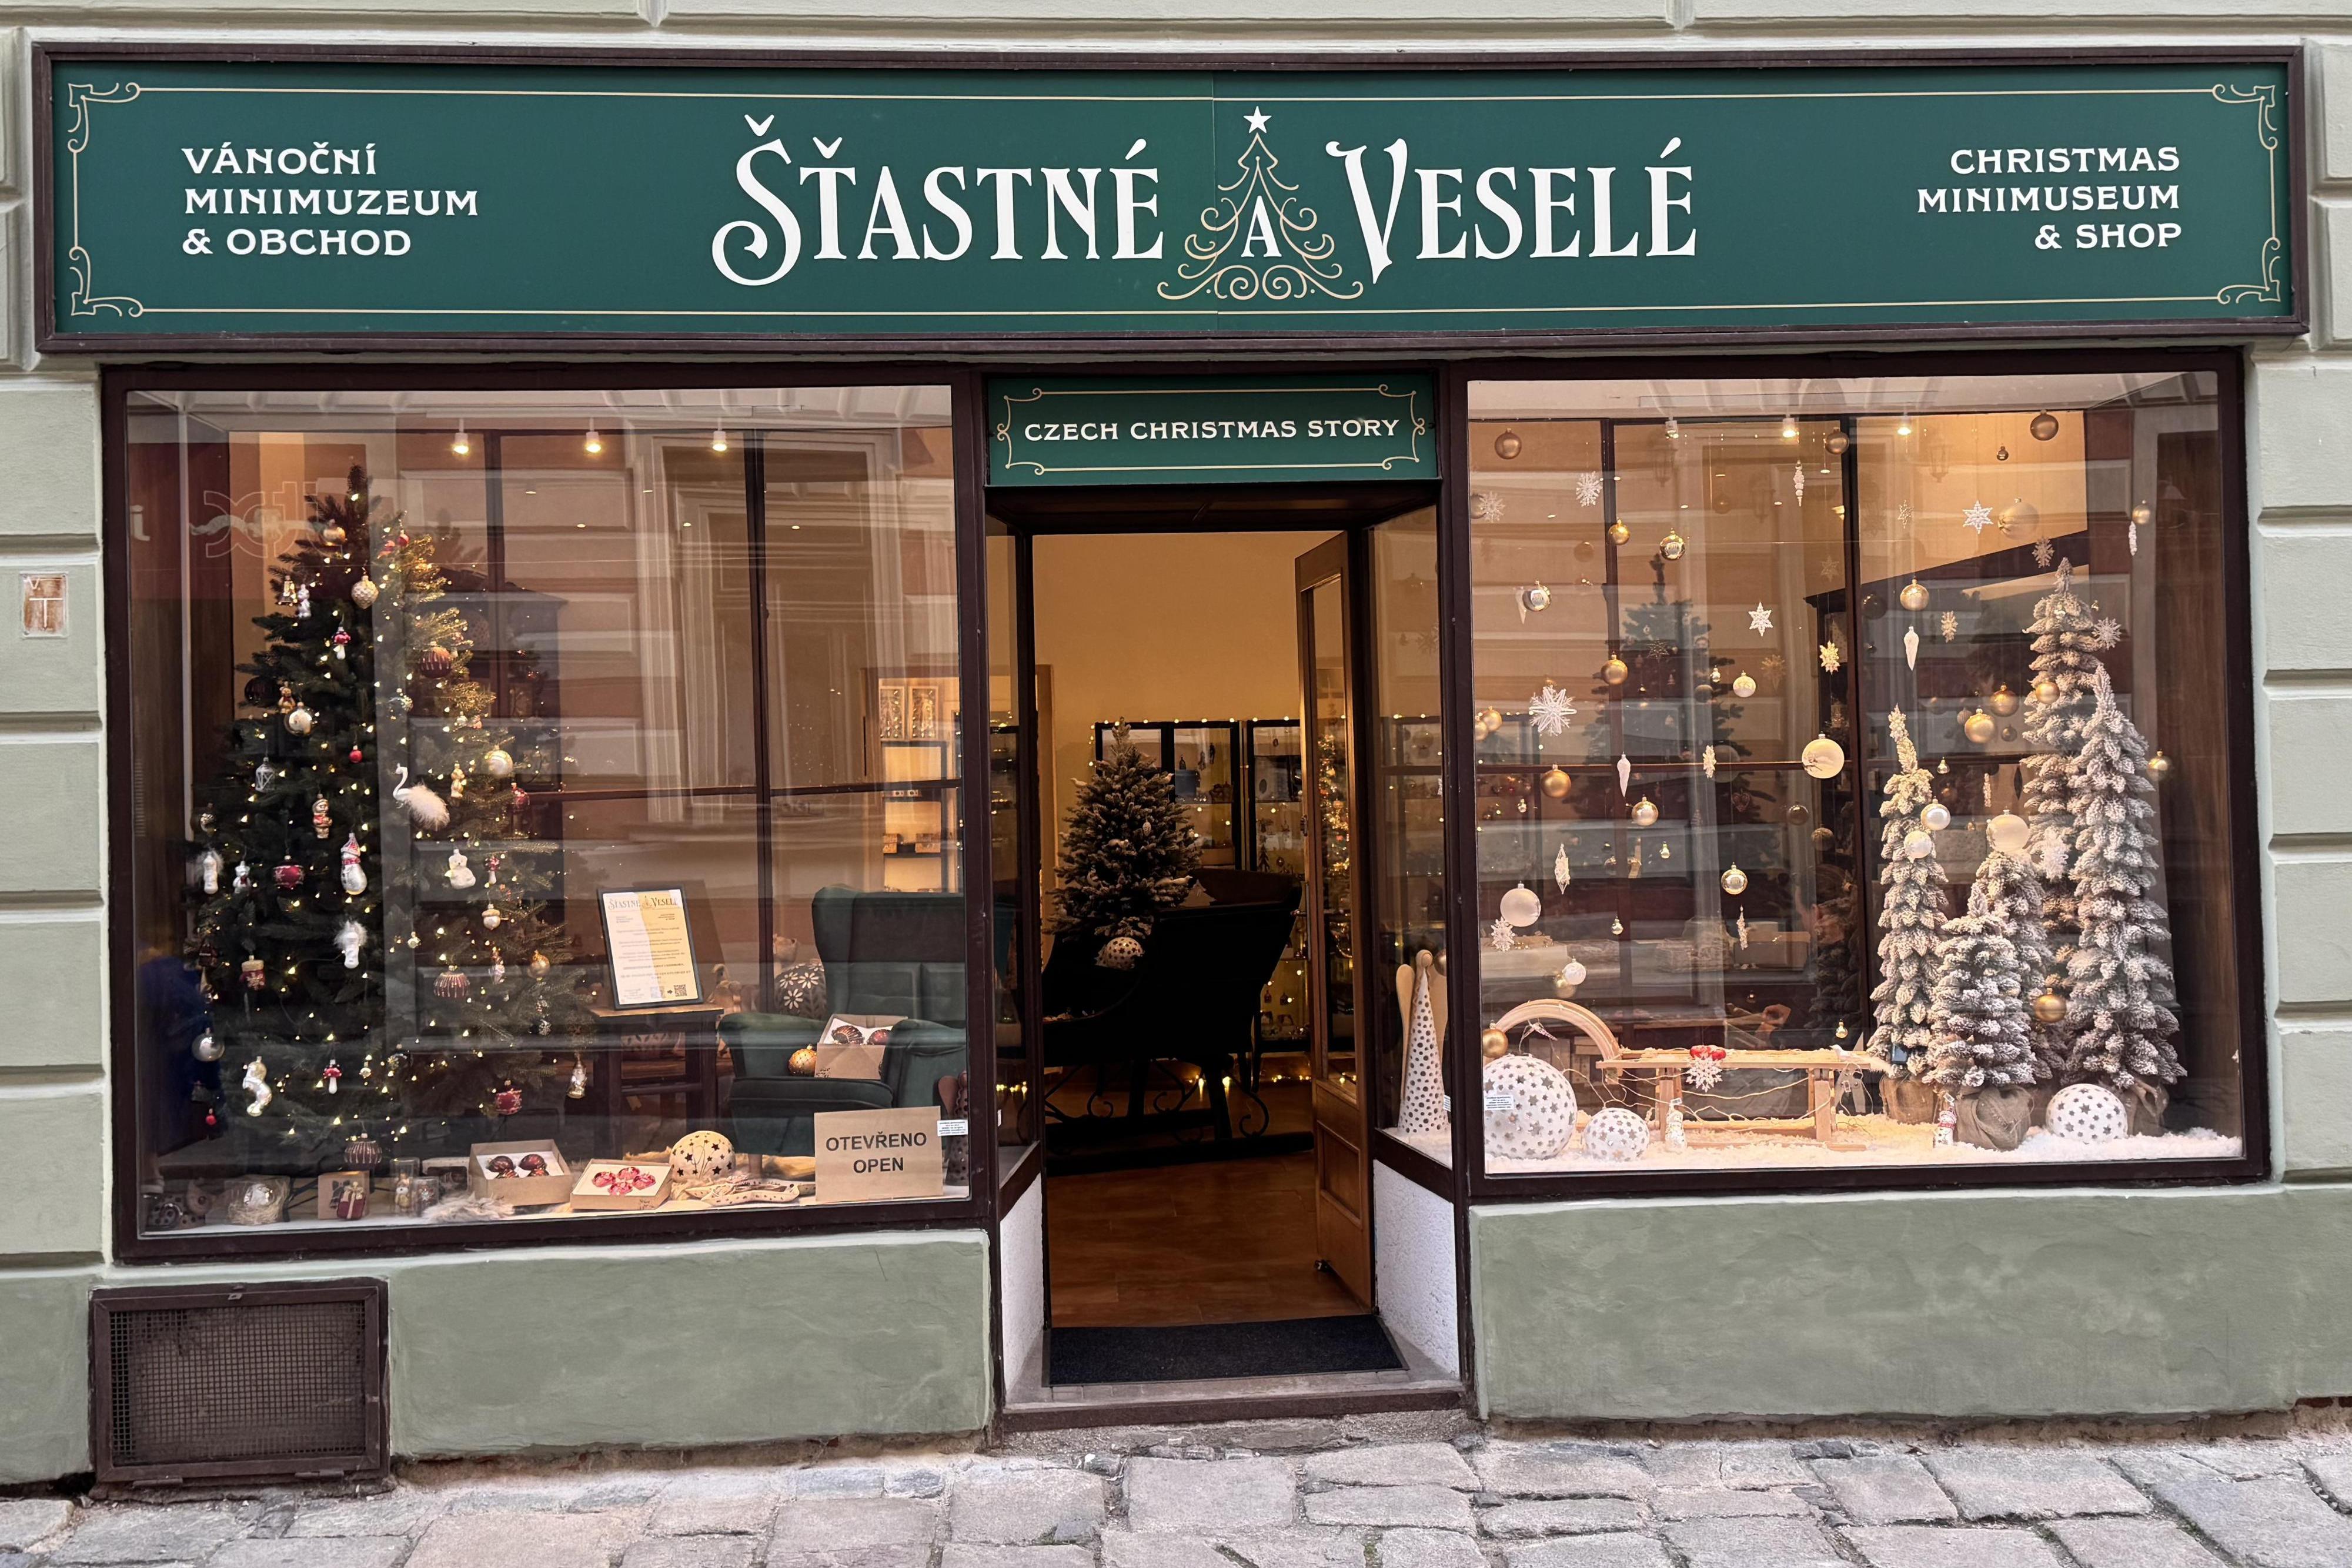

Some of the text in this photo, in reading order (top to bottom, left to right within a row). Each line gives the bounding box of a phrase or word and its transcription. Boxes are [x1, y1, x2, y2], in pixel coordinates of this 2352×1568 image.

[182, 142, 376, 175] VÁNOČNÍ
[1950, 146, 2180, 175] CHRISTMAS
[184, 188, 479, 216] MINIMUZEUM
[711, 114, 1697, 286] ŠŤASTNÉ A VESELÉ
[1917, 185, 2180, 213] MINIMUSEUM
[182, 228, 412, 256] & OBCHOD
[2034, 223, 2182, 250] & SHOP
[1024, 419, 1400, 442] CZECH CHRISTMAS STORY
[826, 1131, 927, 1151] OTEVŘENO
[853, 1157, 904, 1174] OPEN
